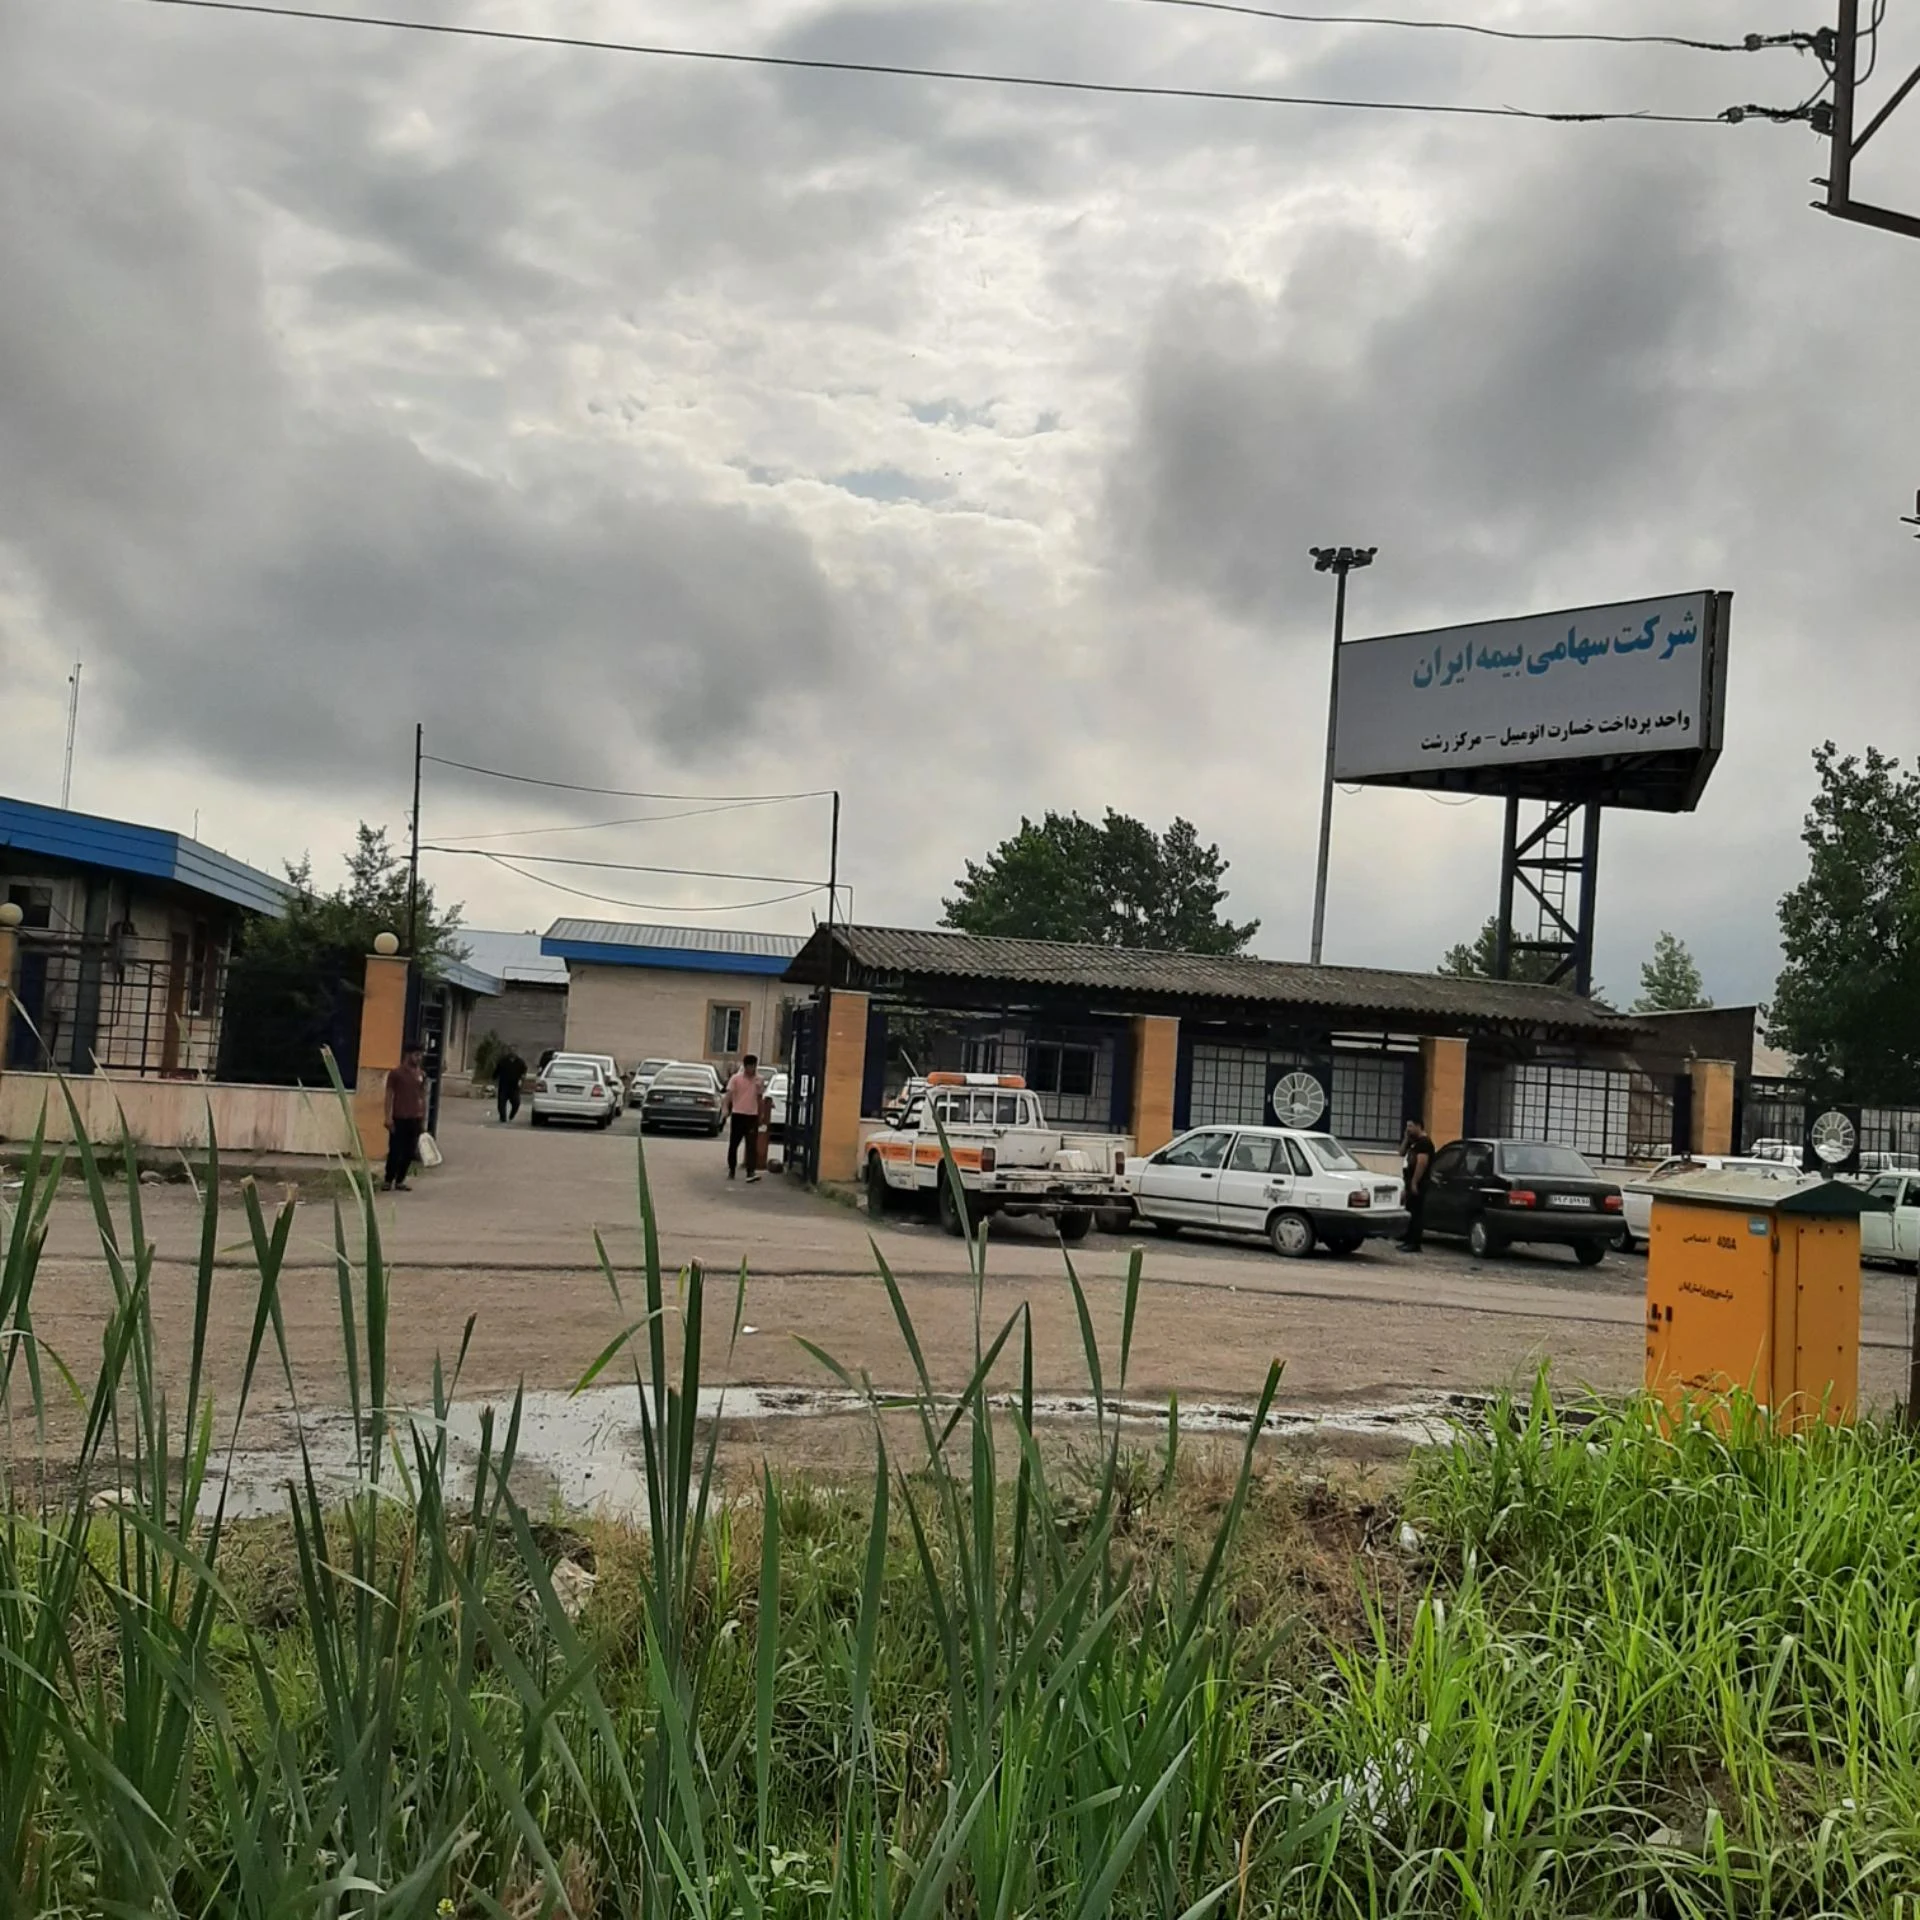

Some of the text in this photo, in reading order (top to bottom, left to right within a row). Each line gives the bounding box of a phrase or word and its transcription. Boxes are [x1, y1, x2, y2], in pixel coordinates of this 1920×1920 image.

[1412, 610, 1698, 689] شرکت سهامی بیمه ایران
[1547, 719, 1595, 742] خسارت
[1598, 715, 1651, 735] پرداخت
[1654, 709, 1691, 731] واحد
[1420, 733, 1449, 752] رشت
[1452, 732, 1482, 752] مرکز
